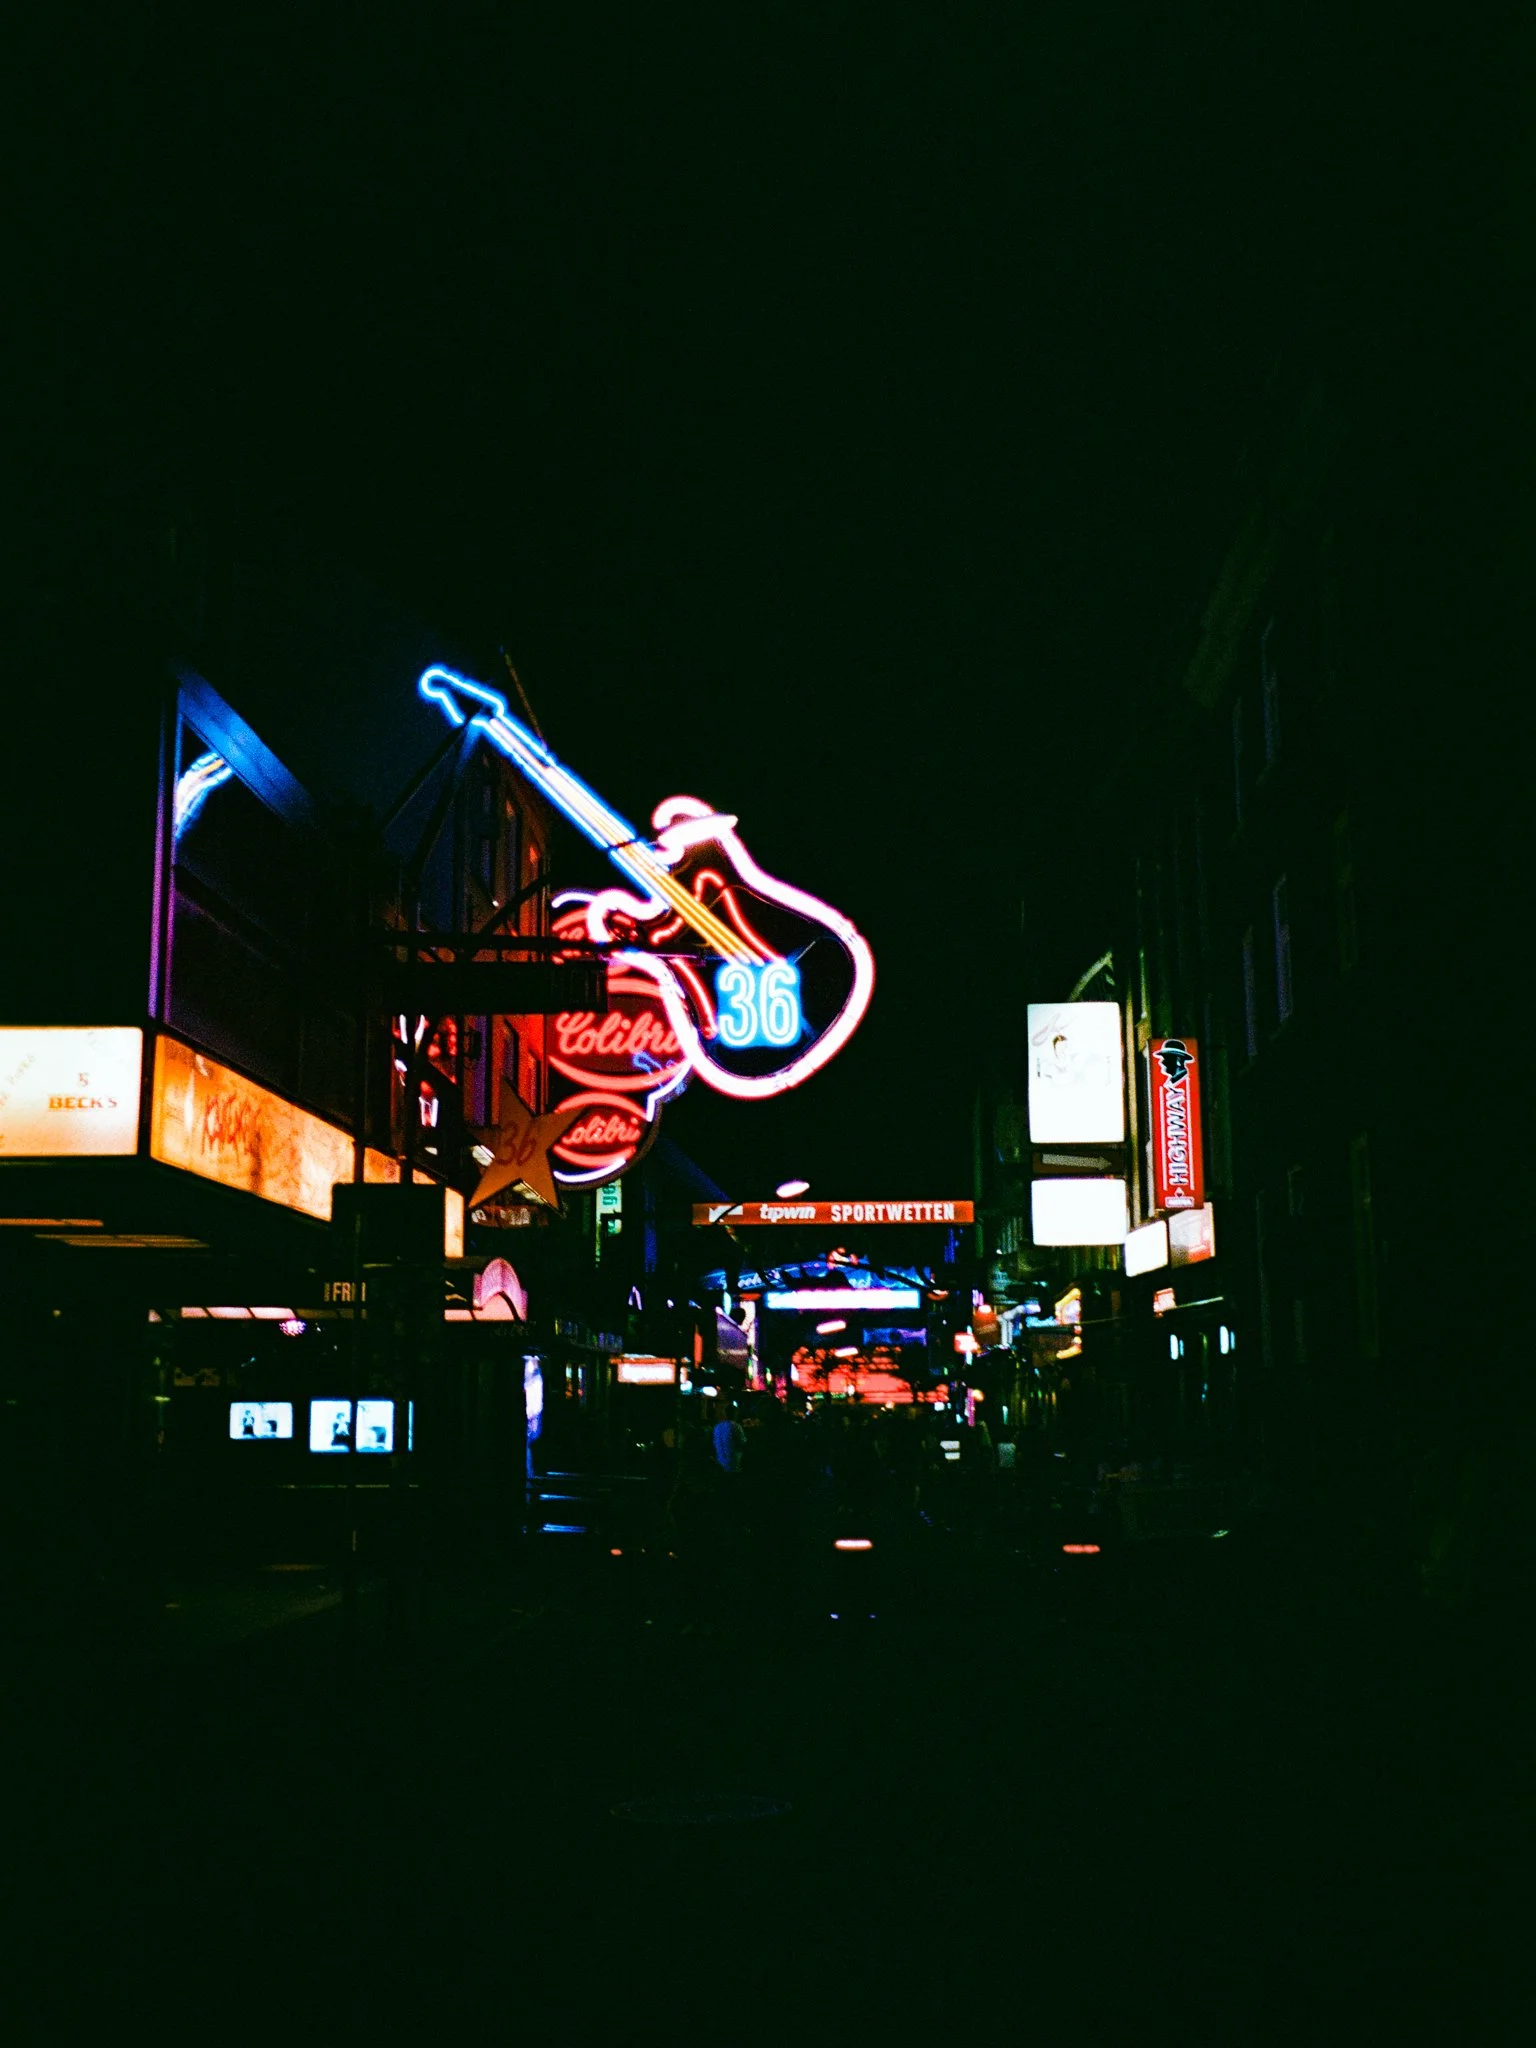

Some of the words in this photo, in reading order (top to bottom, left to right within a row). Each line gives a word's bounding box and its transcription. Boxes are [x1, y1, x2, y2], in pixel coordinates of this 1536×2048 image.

[717, 962, 800, 1047] 36
[495, 1118, 538, 1167] 36
[561, 1114, 642, 1146] olibri
[1162, 1083, 1189, 1186] HIGHWAY
[759, 1203, 816, 1223] tipwin
[830, 1202, 956, 1223] SPORTWETTEN
